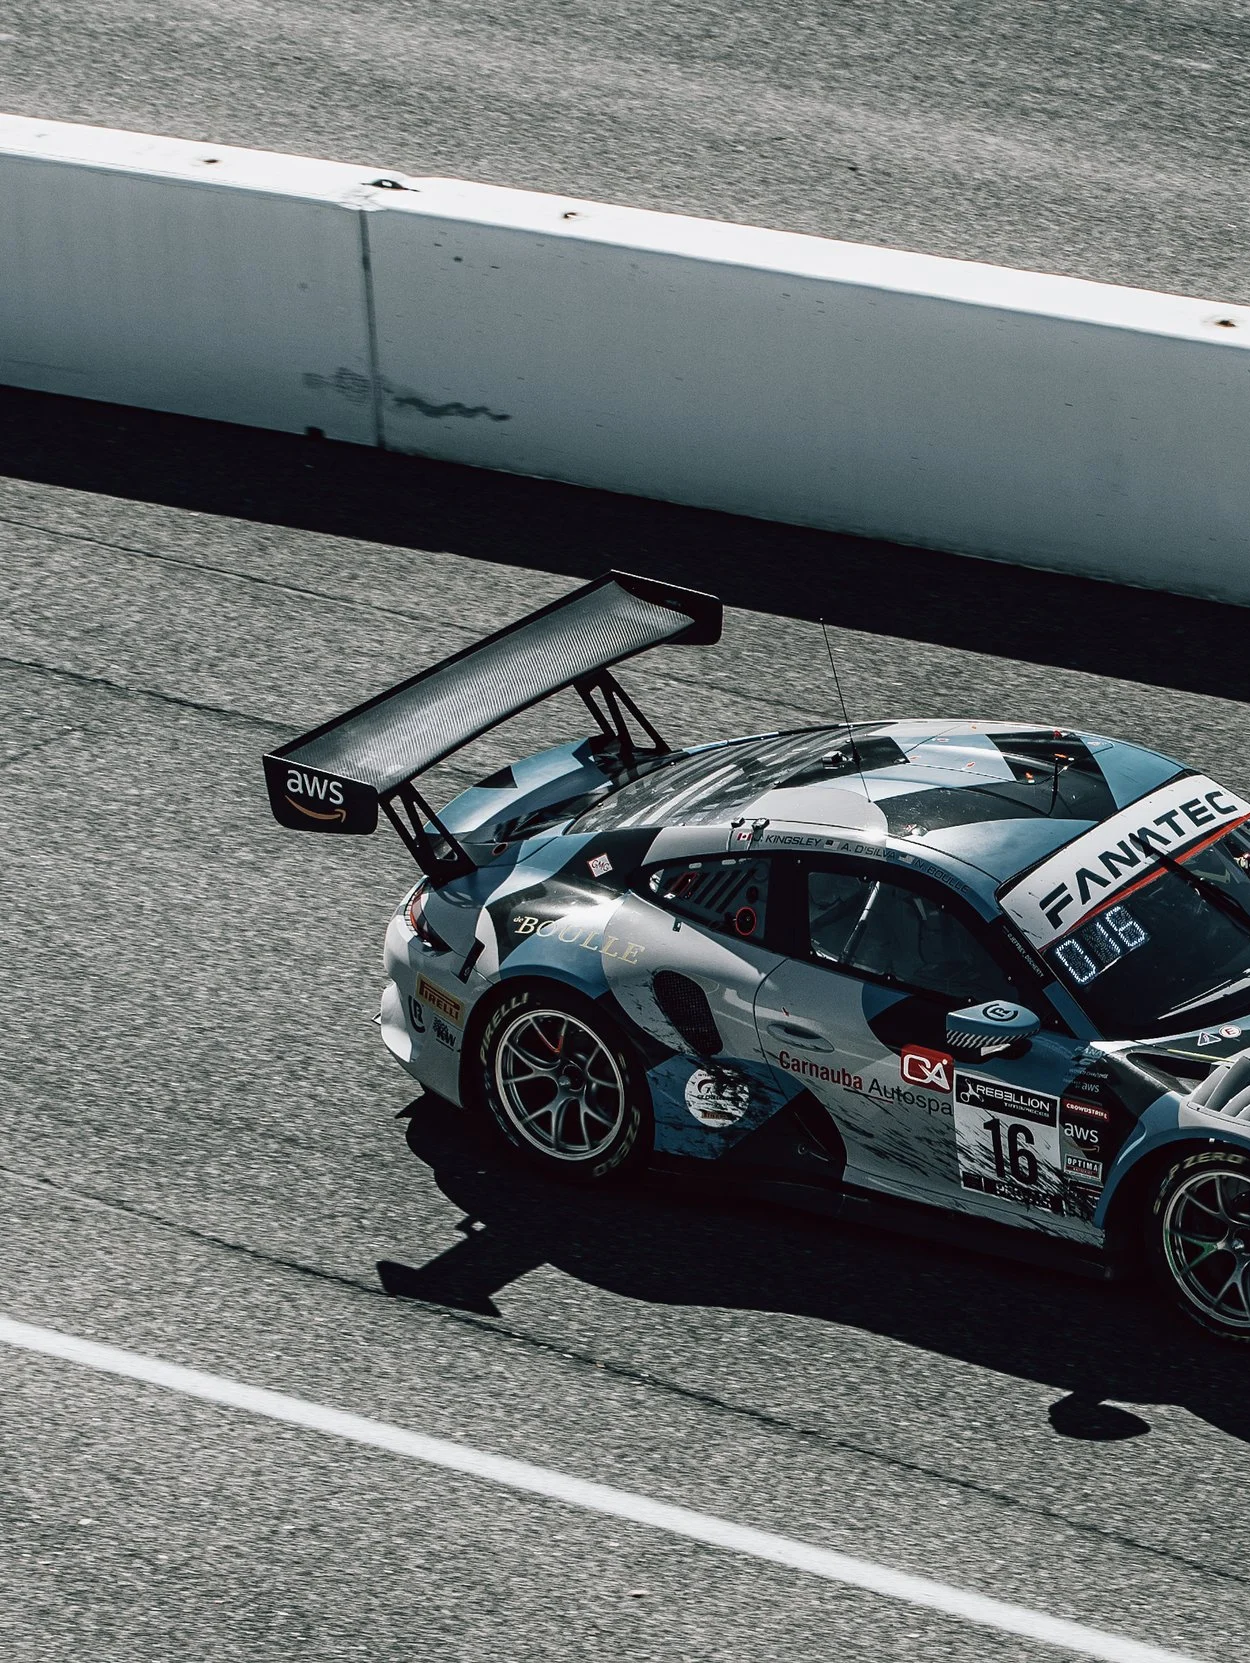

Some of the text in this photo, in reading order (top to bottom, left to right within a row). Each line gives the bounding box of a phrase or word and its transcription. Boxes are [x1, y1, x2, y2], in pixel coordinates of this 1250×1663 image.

[287, 769, 344, 805] aws
[766, 834, 821, 848] KINGSLEY
[841, 843, 896, 860] A. D'SILVA
[591, 860, 609, 871] GMG
[913, 860, 971, 896] N. BOULLE
[1039, 791, 1238, 930] FANATEC
[514, 916, 646, 965] BOULLE
[1055, 905, 1147, 983] 016
[419, 980, 462, 1019] PIRELLI
[480, 992, 530, 1065] PIRELLI
[779, 1050, 954, 1116] Carnauba Autospa
[976, 1084, 1050, 1112] REBELLION
[1081, 1082, 1100, 1093] aws
[1064, 1122, 1099, 1143] aws
[983, 1118, 1039, 1185] 16
[1066, 1157, 1098, 1171] OPTIMA
[1183, 1151, 1247, 1170] ZERO
